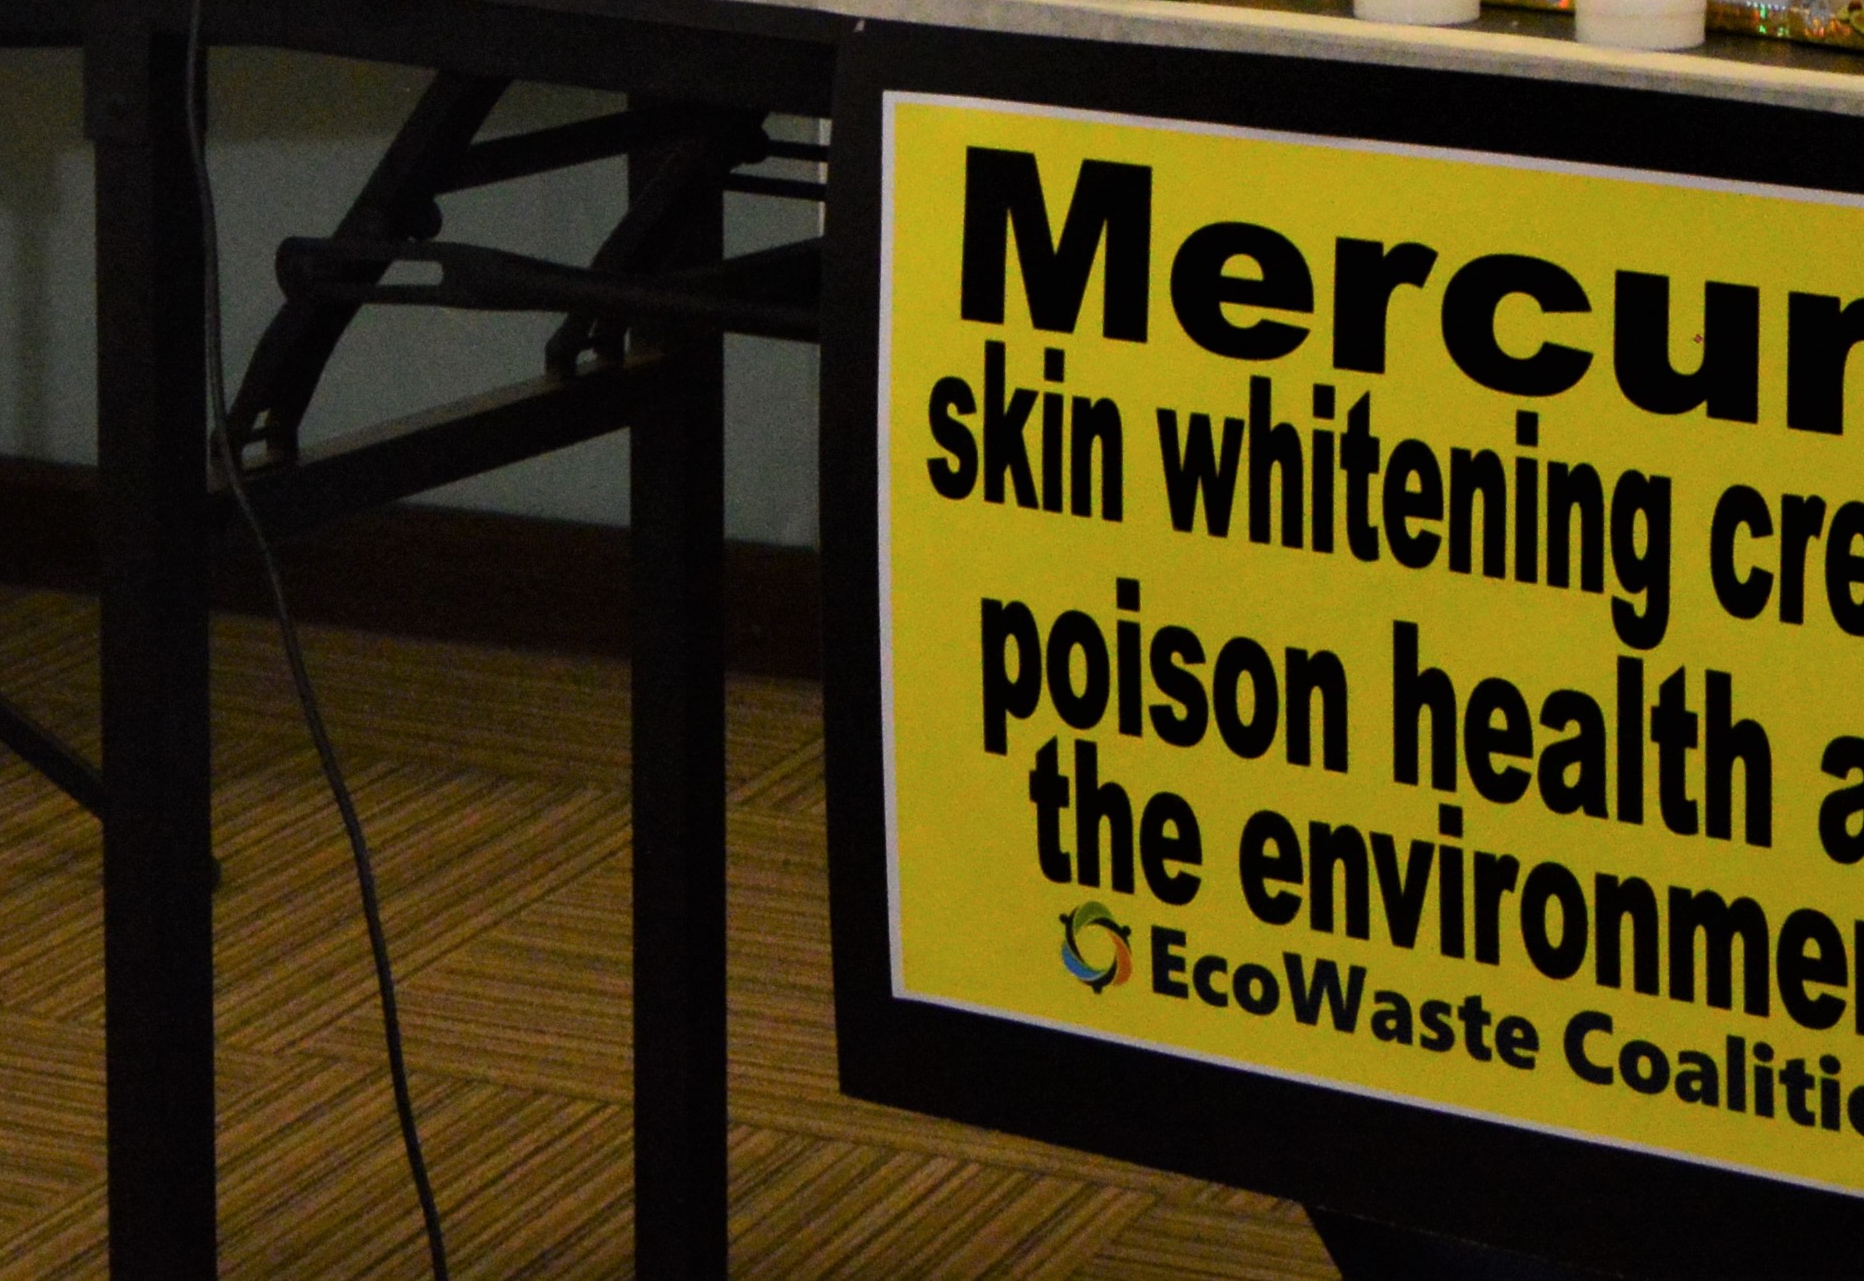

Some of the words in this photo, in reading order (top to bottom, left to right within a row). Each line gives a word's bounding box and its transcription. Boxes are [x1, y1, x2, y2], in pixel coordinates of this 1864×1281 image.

[928, 341, 1123, 522] skin
[1157, 376, 1671, 650] whitening
[981, 578, 1350, 774] poison
[1393, 621, 1772, 848] health
[1029, 738, 1202, 905] the
[1151, 926, 1539, 1070] EcoWaste
